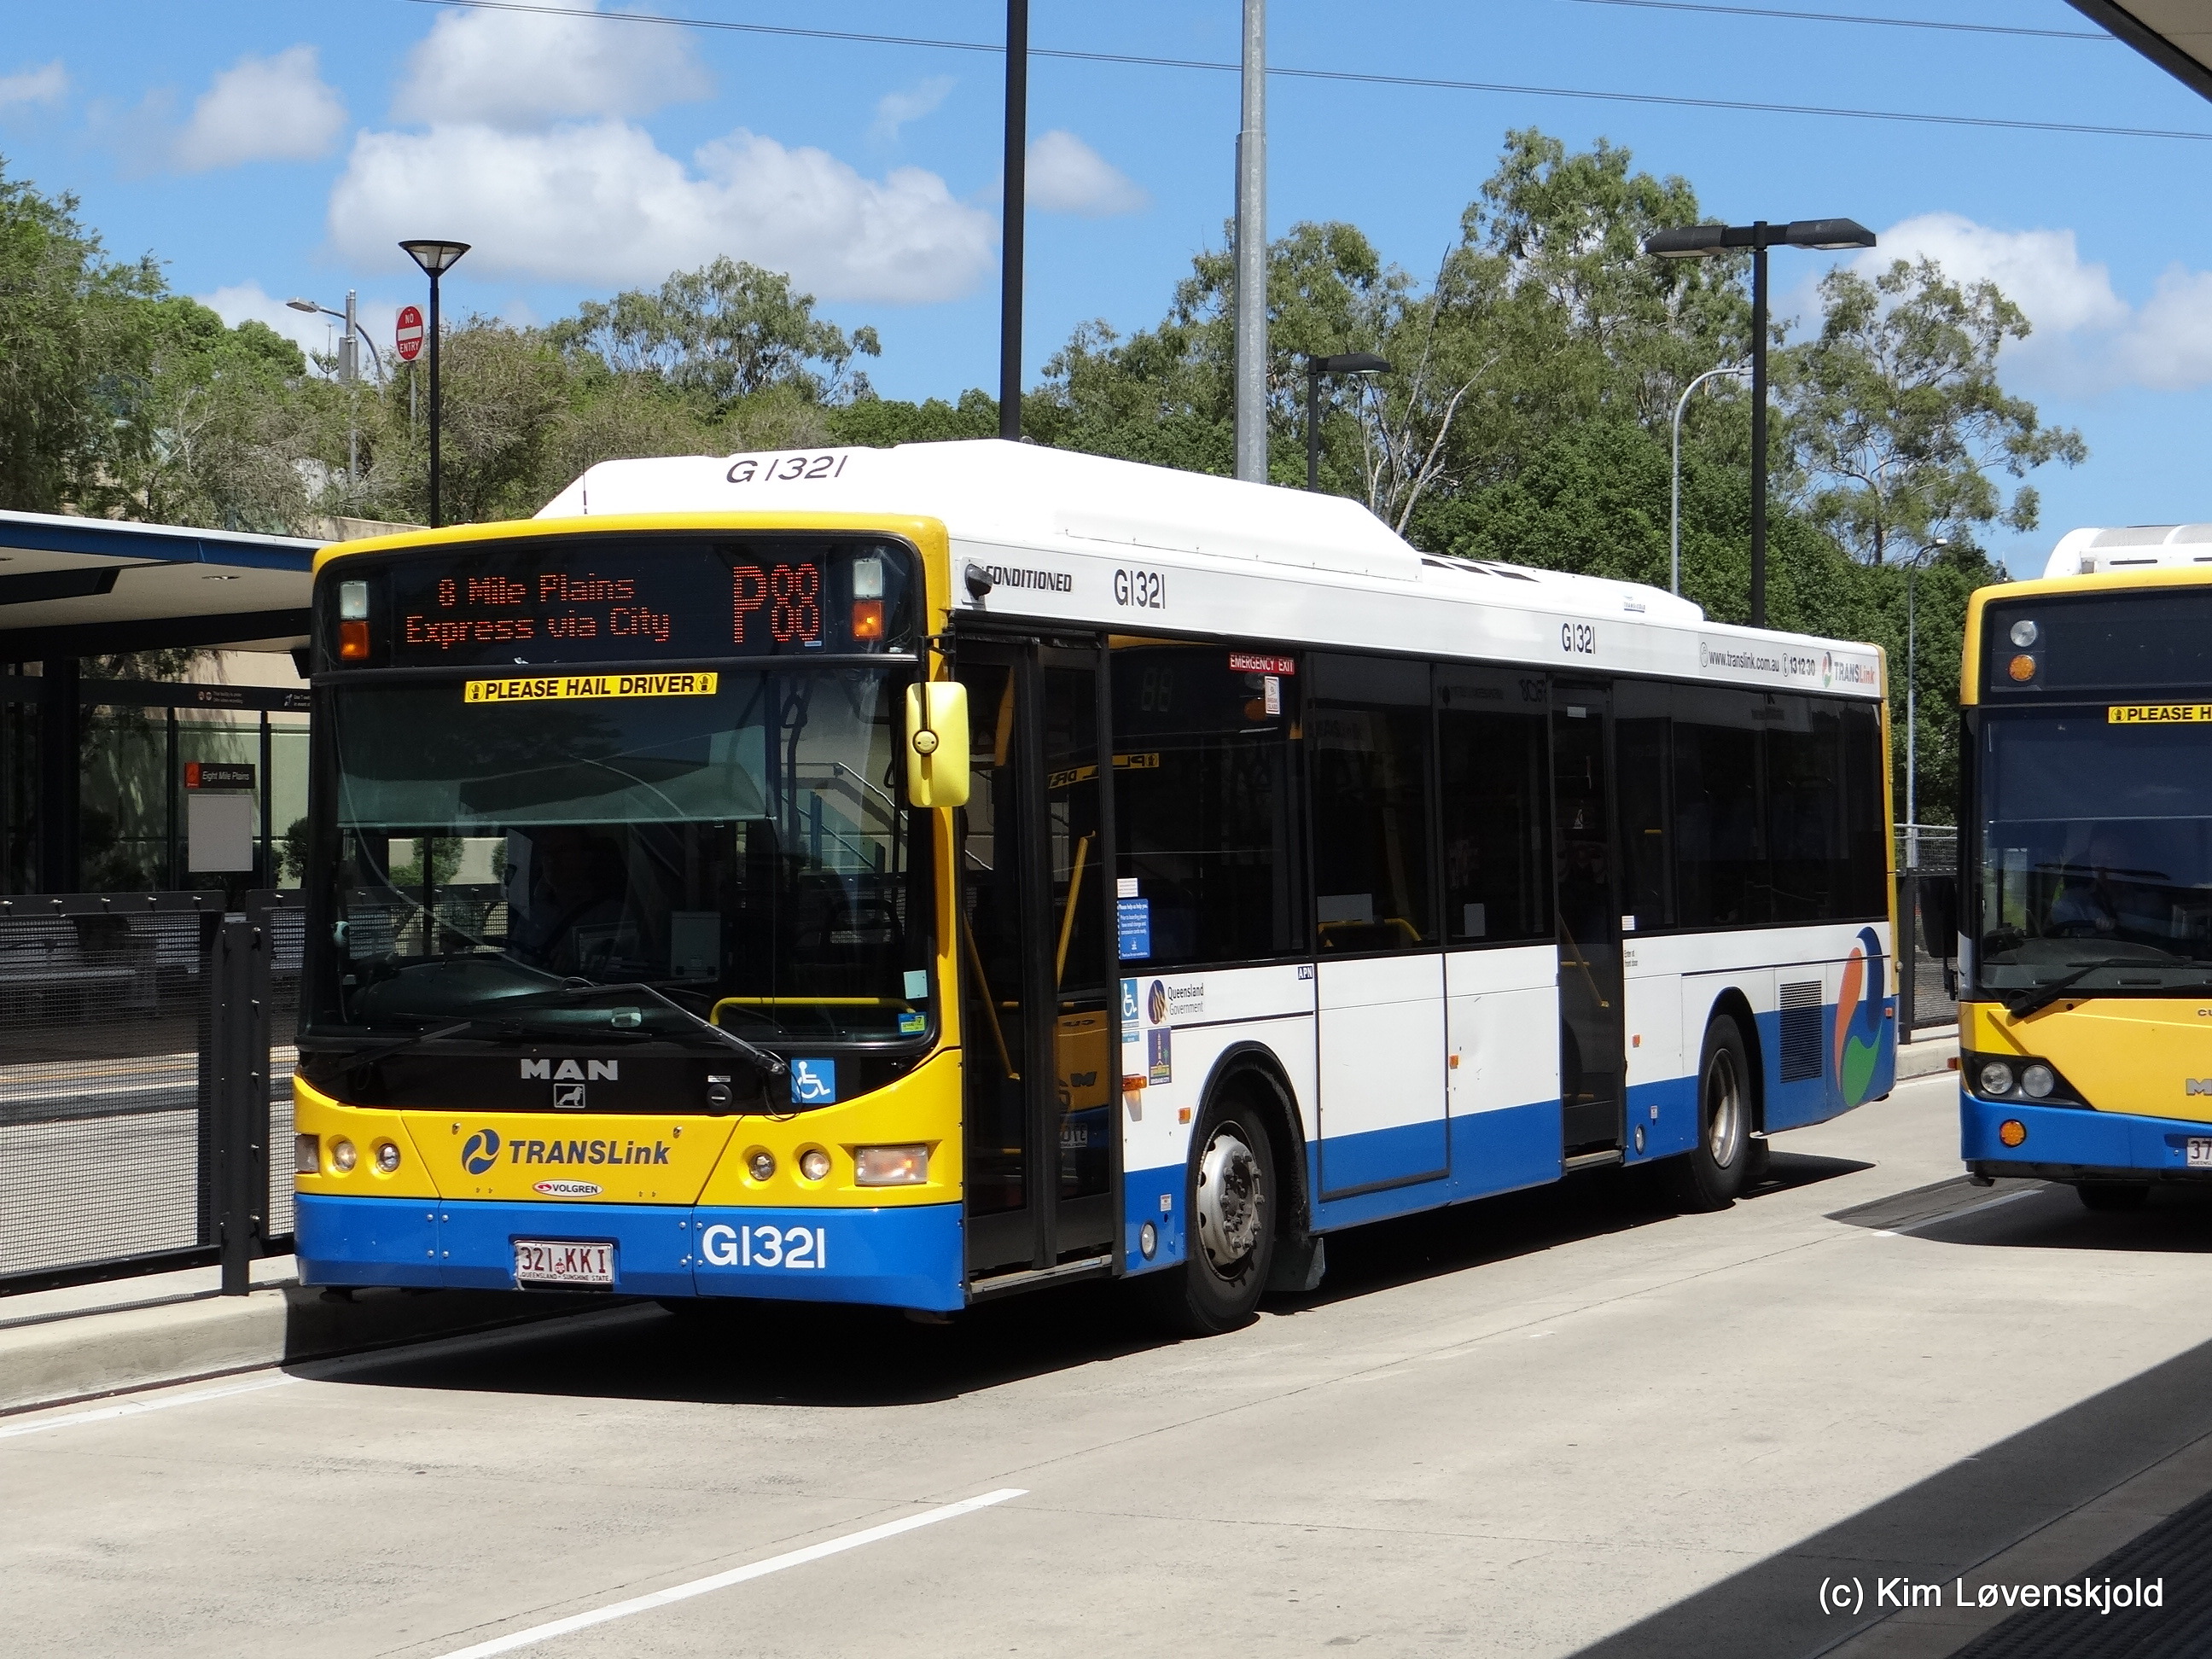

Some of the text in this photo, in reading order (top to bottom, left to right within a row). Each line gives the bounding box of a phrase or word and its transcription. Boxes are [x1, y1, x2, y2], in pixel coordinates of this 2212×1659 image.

[405, 313, 415, 324] NO
[399, 341, 420, 353] ENTRY
[726, 455, 848, 484] G1321
[439, 573, 635, 606] 8 Mile Plains
[1114, 568, 1166, 609] G1321
[732, 563, 819, 643] P88
[406, 606, 670, 649] Express via City
[1561, 622, 1596, 655] G1321
[1230, 655, 1294, 672] EMERGENCY EXIT
[1708, 650, 1779, 672] www.translink.com.au
[1834, 661, 1875, 685] TRANSLink
[485, 674, 695, 700] PLEASE HAIL DRIVER
[2127, 707, 2193, 721] PLEASE
[202, 771, 250, 782] Eight Mile Plains
[1298, 966, 1313, 979] APN
[1167, 982, 1204, 1001] Queensland
[1169, 1001, 1204, 1016] Government
[521, 1058, 619, 1080] MAN
[509, 1140, 672, 1165] TRANSLink
[552, 1184, 598, 1194] VOLGREN
[702, 1224, 825, 1269] G1321
[521, 1272, 557, 1280] QUEENSLAND
